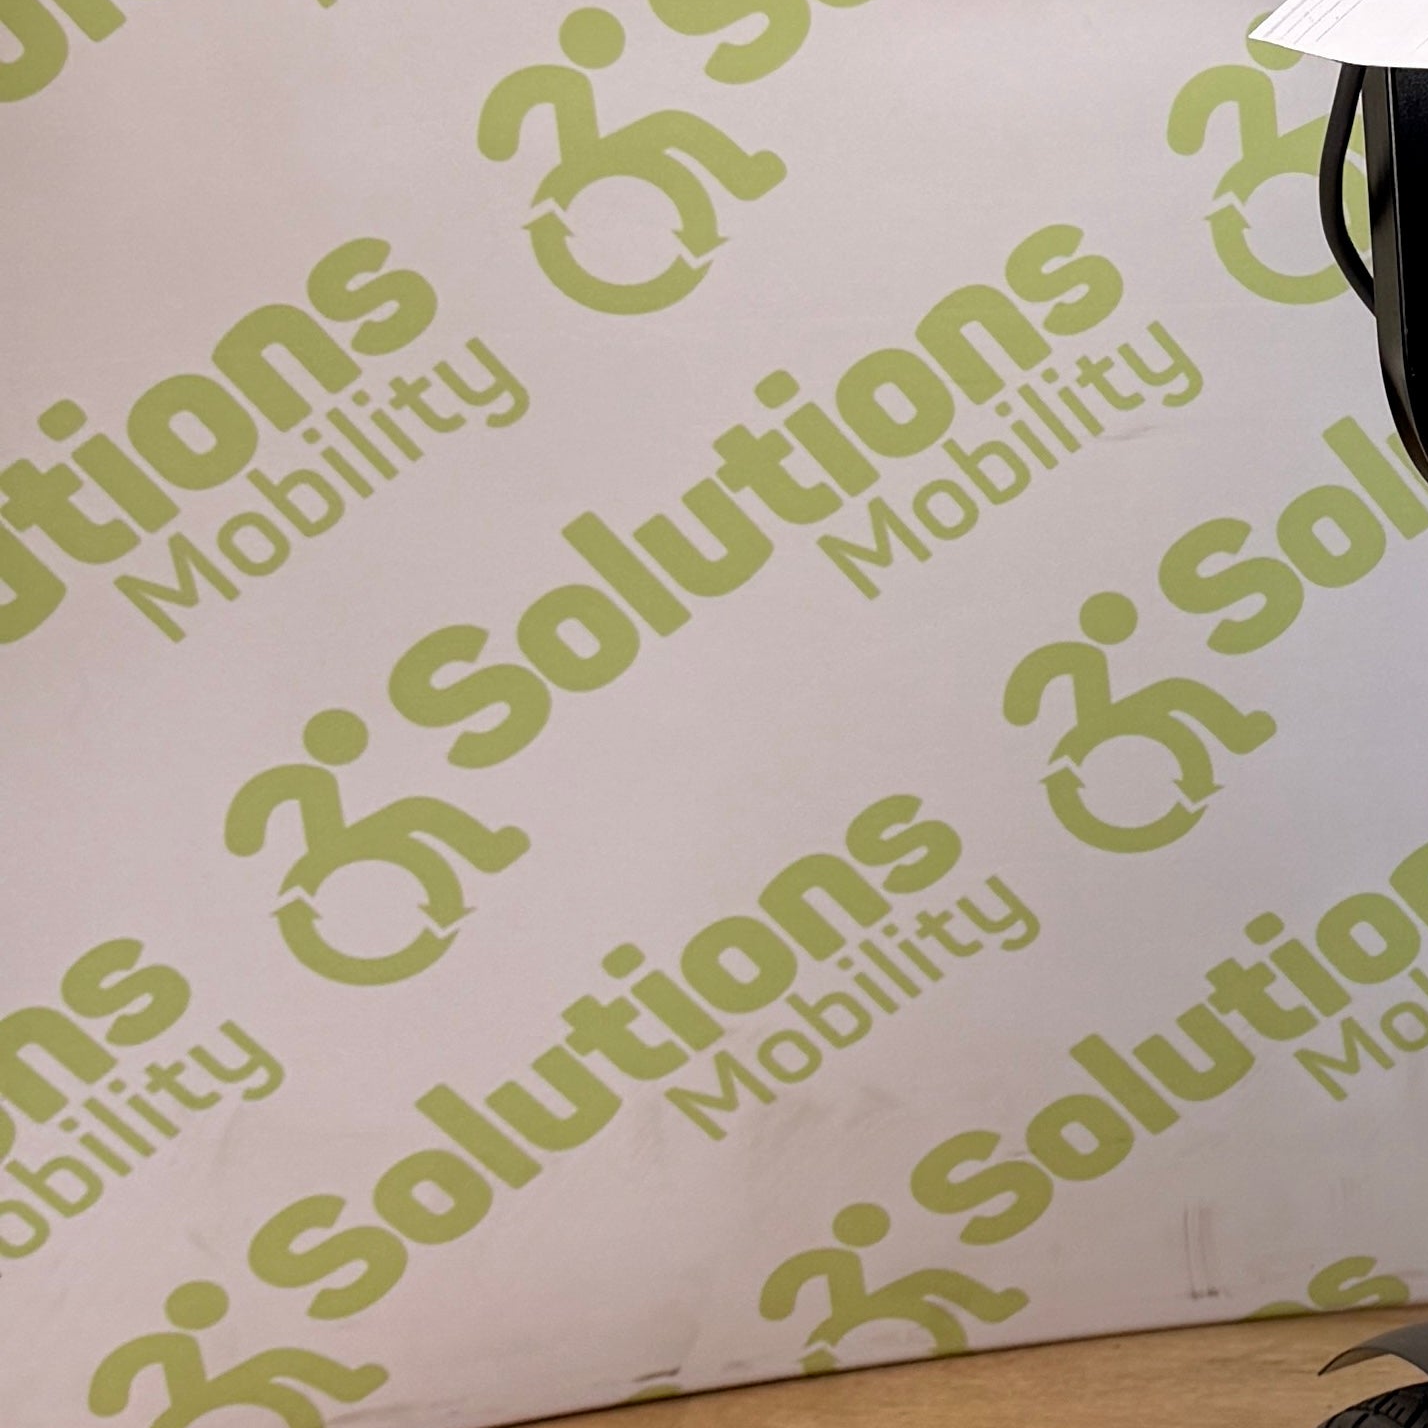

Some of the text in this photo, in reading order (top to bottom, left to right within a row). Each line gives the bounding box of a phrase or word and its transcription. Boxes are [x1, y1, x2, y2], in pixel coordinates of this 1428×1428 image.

[0, 240, 434, 642] utions
[116, 341, 527, 640] Mobility
[389, 227, 1121, 767] Solutions
[820, 325, 1200, 596] Mobility
[0, 1024, 281, 1257] obility
[249, 797, 959, 1318] Solutions
[666, 880, 1038, 1138] Mobility
